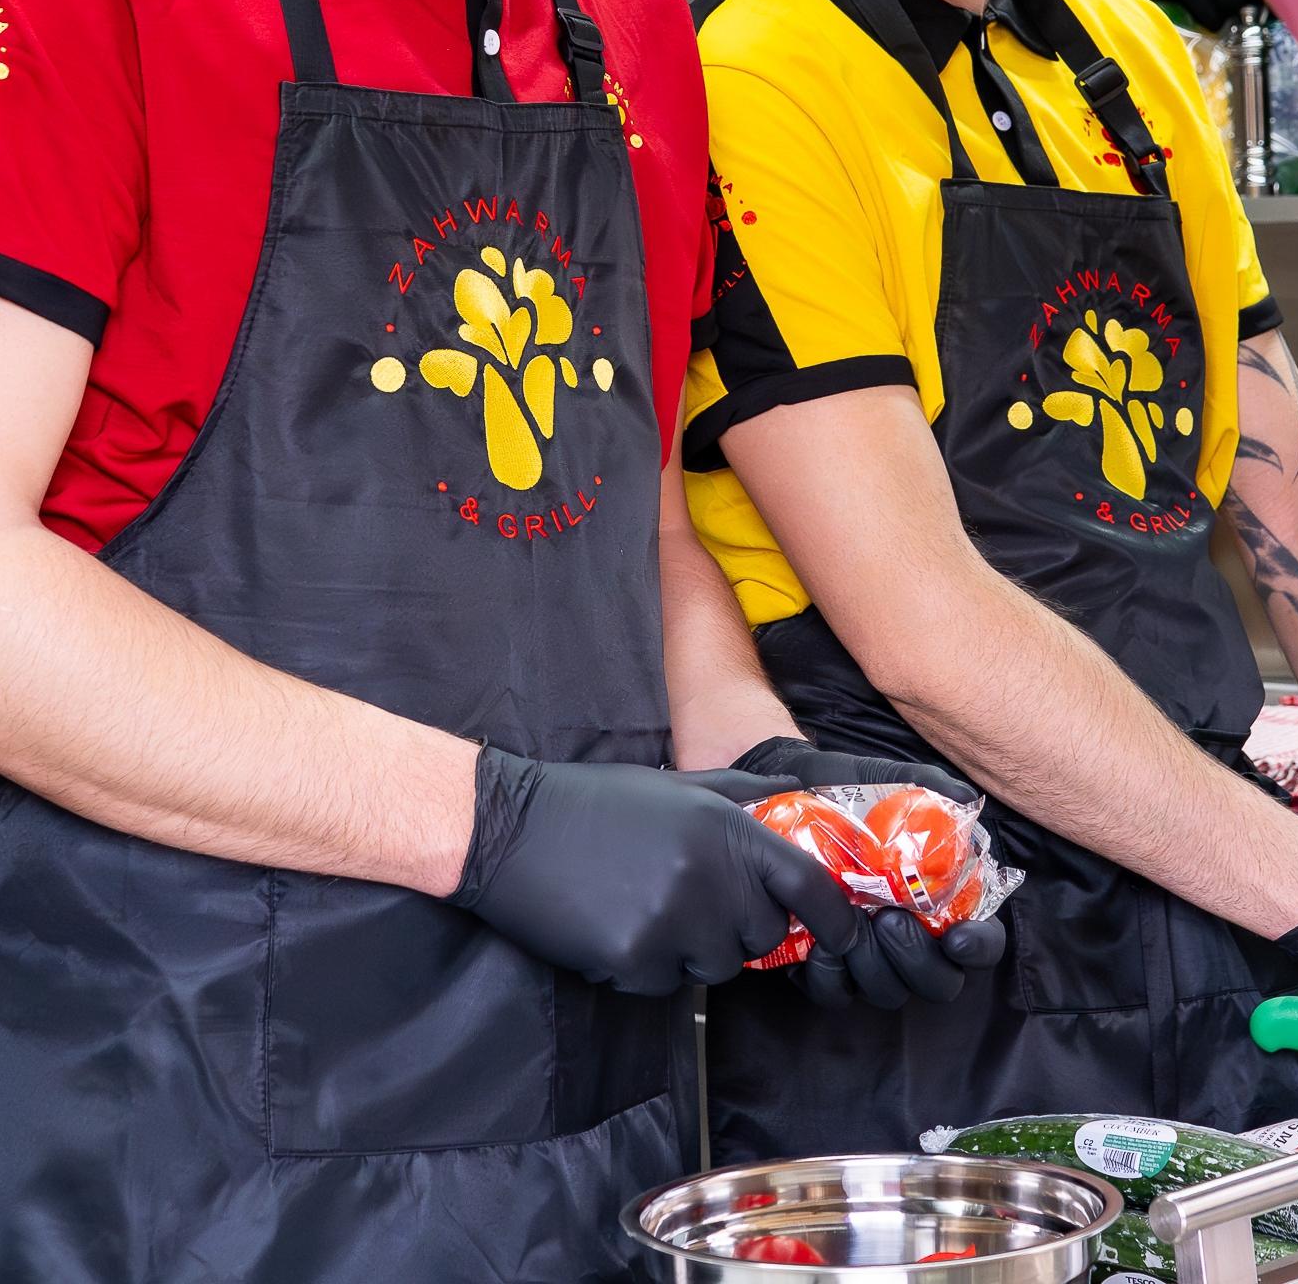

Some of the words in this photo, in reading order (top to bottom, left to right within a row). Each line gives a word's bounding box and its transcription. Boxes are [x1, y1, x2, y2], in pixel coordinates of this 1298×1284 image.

[388, 195, 587, 301] ZAHWARMA
[1029, 269, 1181, 357] ZAHWARMA
[459, 496, 480, 526] &
[498, 490, 598, 540] GRILL
[1096, 501, 1115, 524] &
[1130, 505, 1191, 535] GRILL
[1103, 1124, 1161, 1136] CUCUMBER
[1125, 1276, 1156, 1284] TESCO
